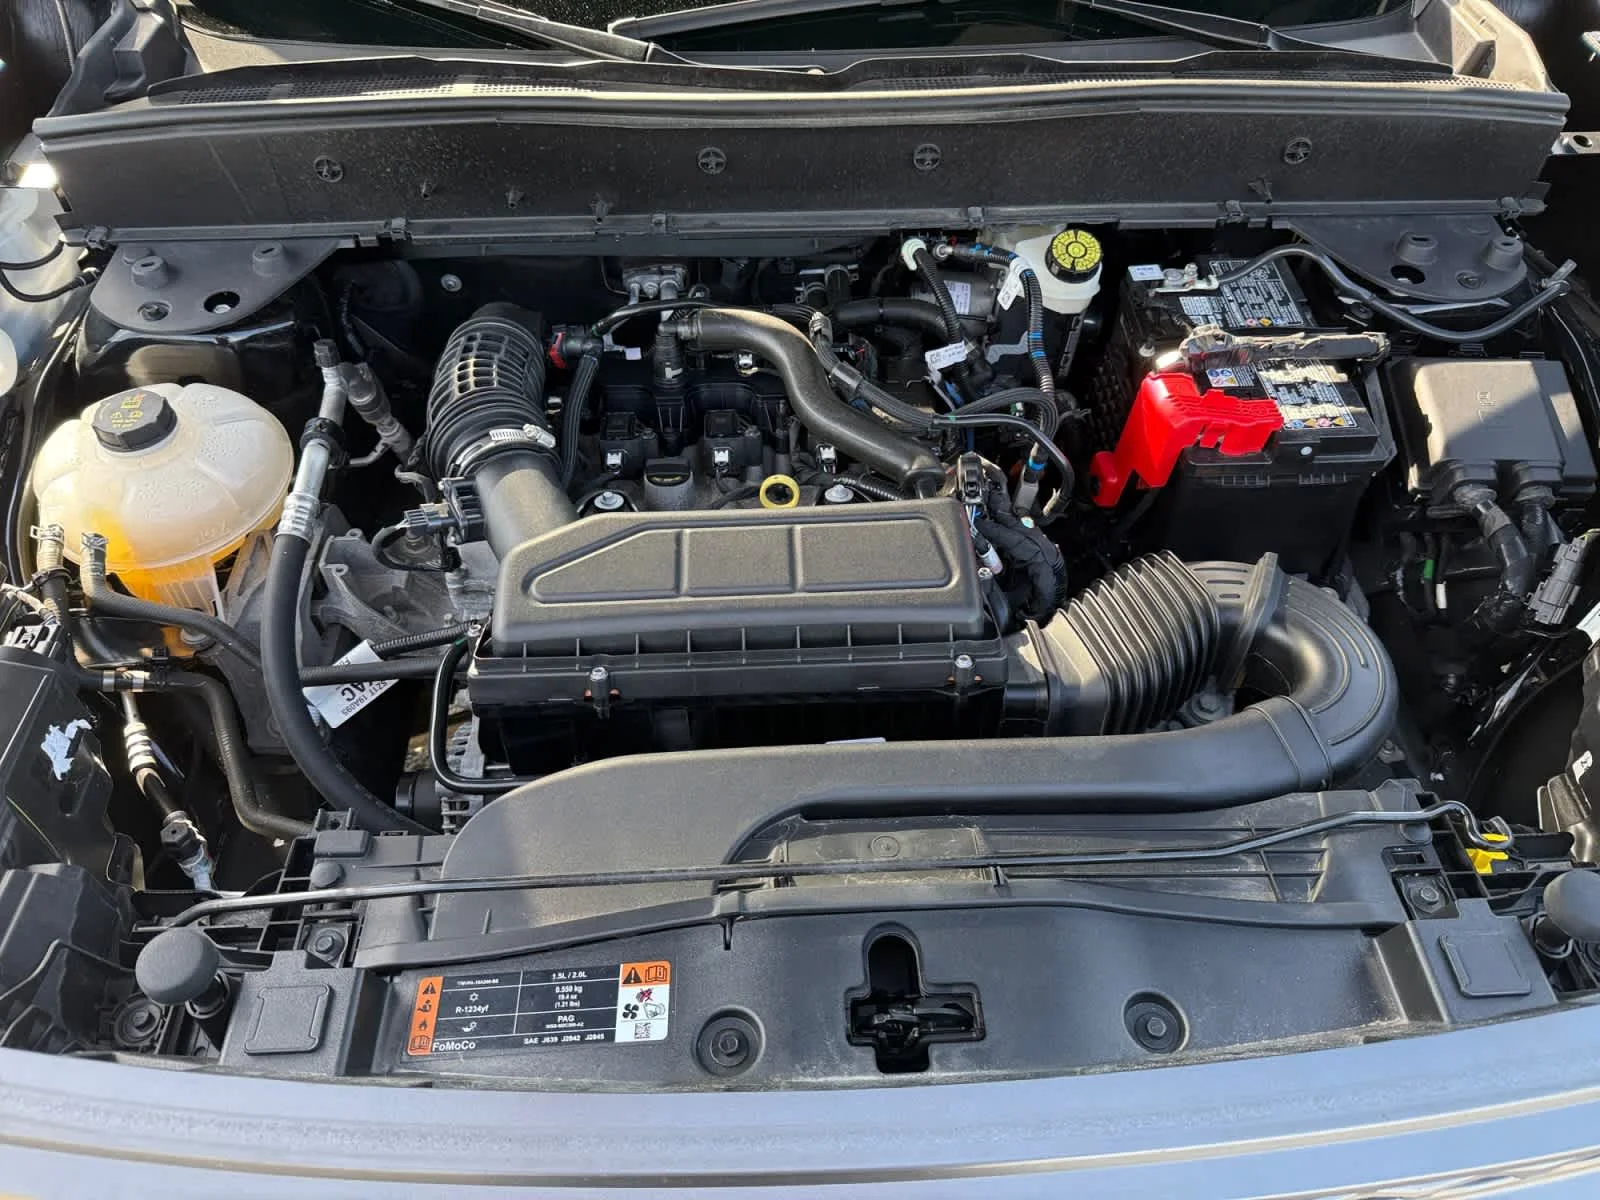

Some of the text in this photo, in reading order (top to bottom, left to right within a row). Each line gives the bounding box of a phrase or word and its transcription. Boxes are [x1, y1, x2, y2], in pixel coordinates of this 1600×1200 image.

[572, 970, 588, 978] 2.0L
[455, 1004, 489, 1014] R-1234yf
[557, 1015, 575, 1023] PAG
[523, 1037, 539, 1045] SAE
[432, 1040, 476, 1051] FoMoCo
